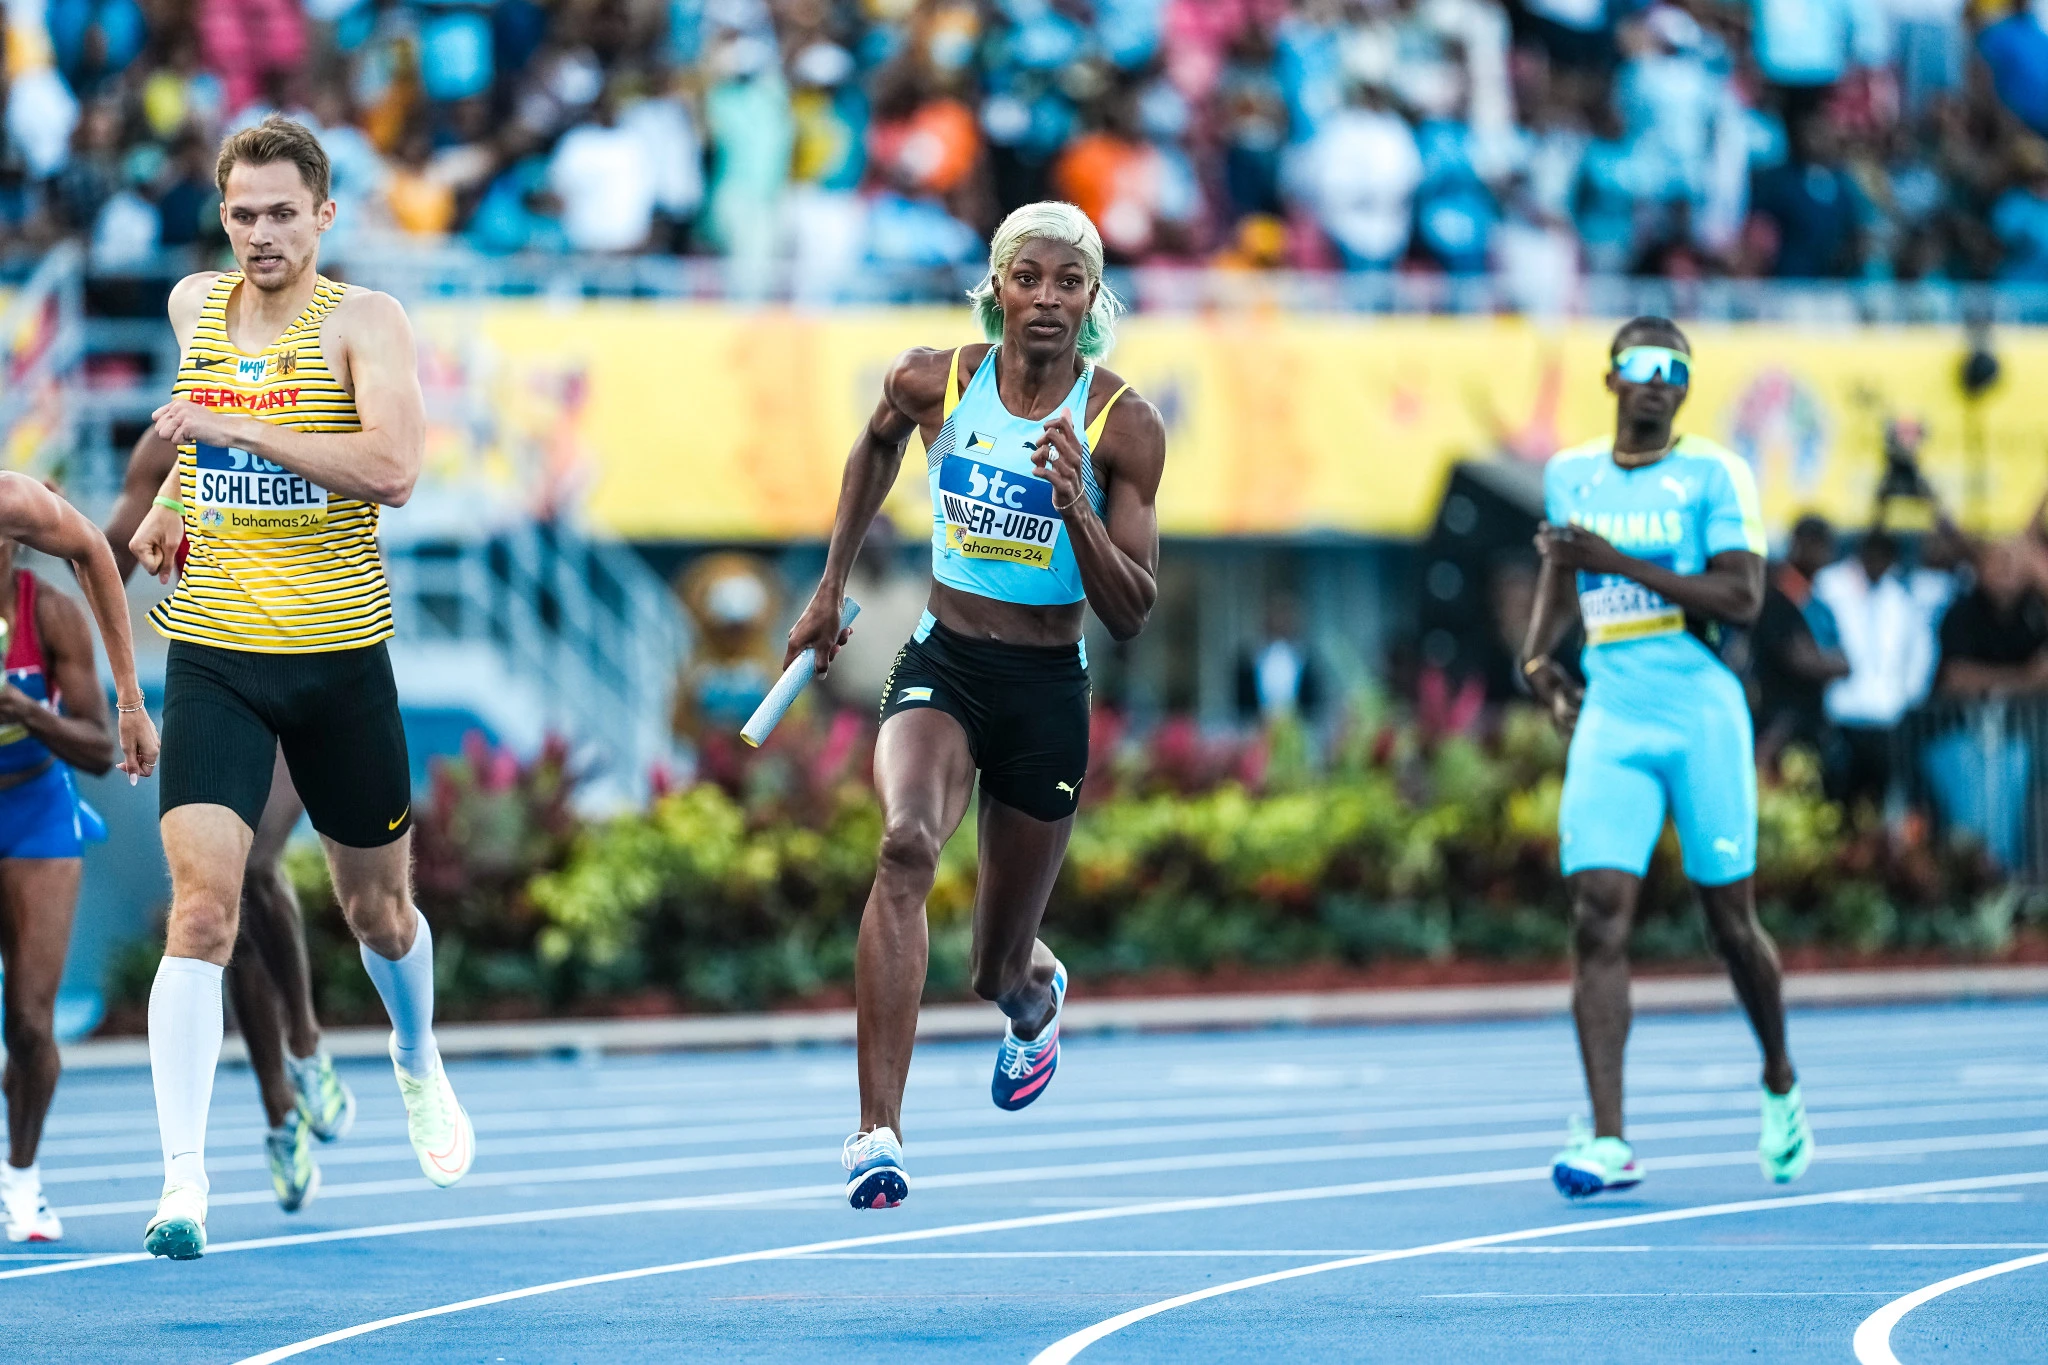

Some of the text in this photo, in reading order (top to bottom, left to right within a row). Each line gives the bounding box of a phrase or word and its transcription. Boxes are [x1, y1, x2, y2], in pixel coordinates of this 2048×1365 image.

[190, 388, 301, 410] GERMANY
[202, 473, 320, 505] SCHLEGEL
[966, 463, 1027, 509] btc
[963, 541, 1043, 562] ahamas24
